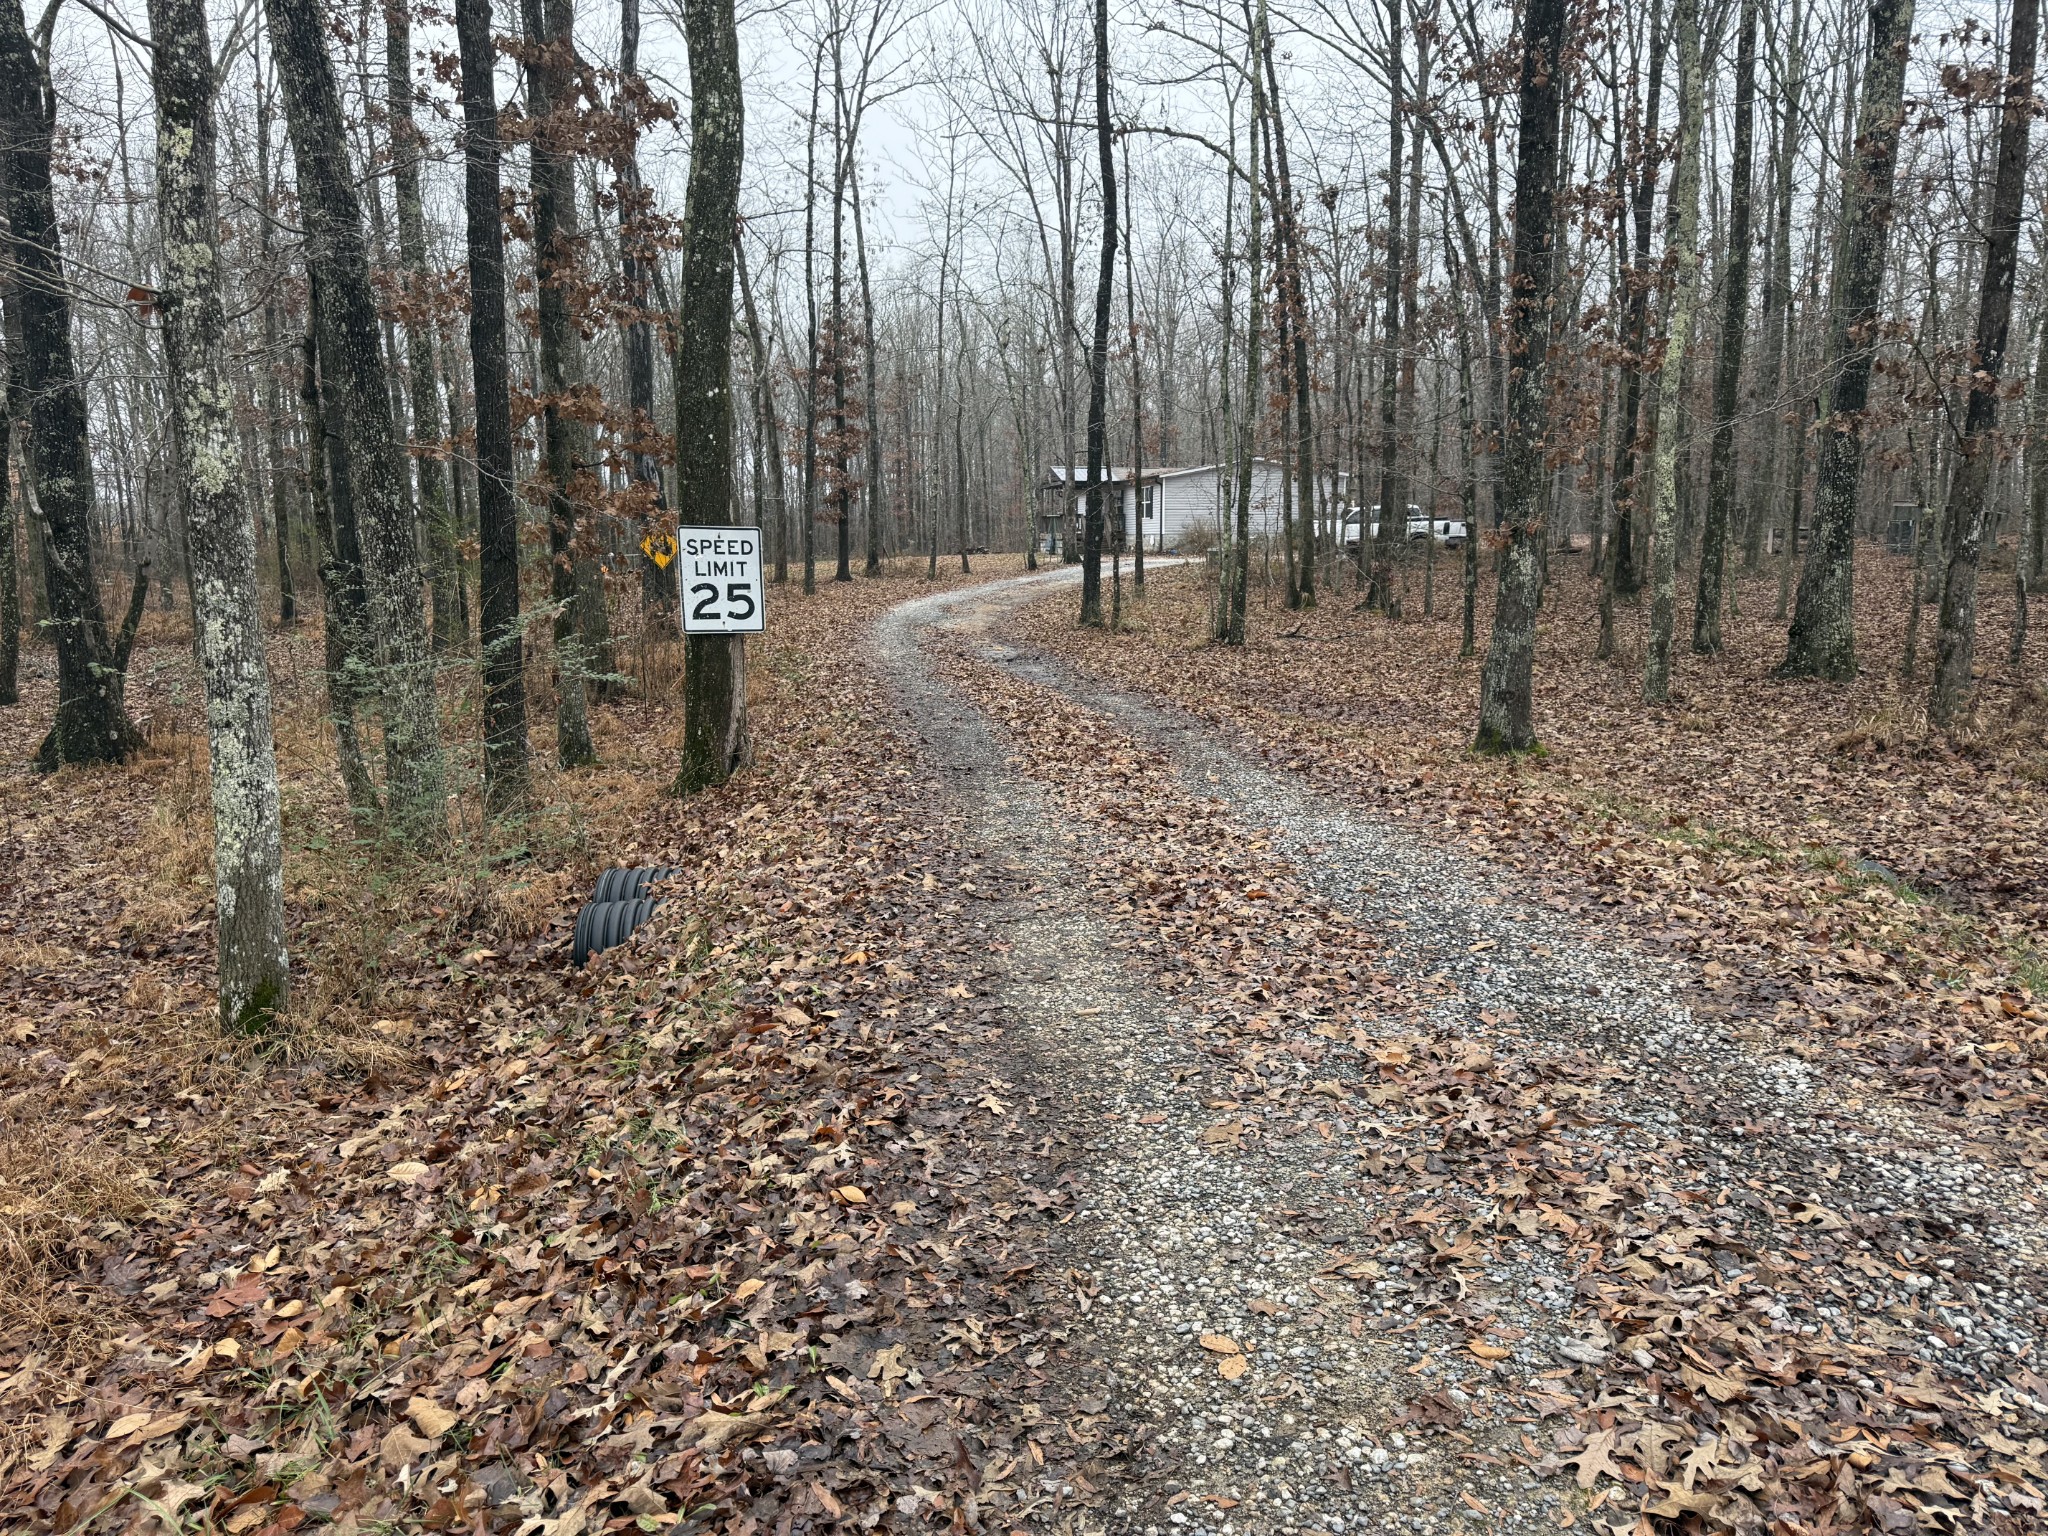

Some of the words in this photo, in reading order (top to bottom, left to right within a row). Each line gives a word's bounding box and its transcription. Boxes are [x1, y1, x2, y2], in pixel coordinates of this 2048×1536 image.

[686, 539, 753, 556] SPEED
[695, 561, 747, 577] LIMIT
[690, 583, 755, 620] 25
